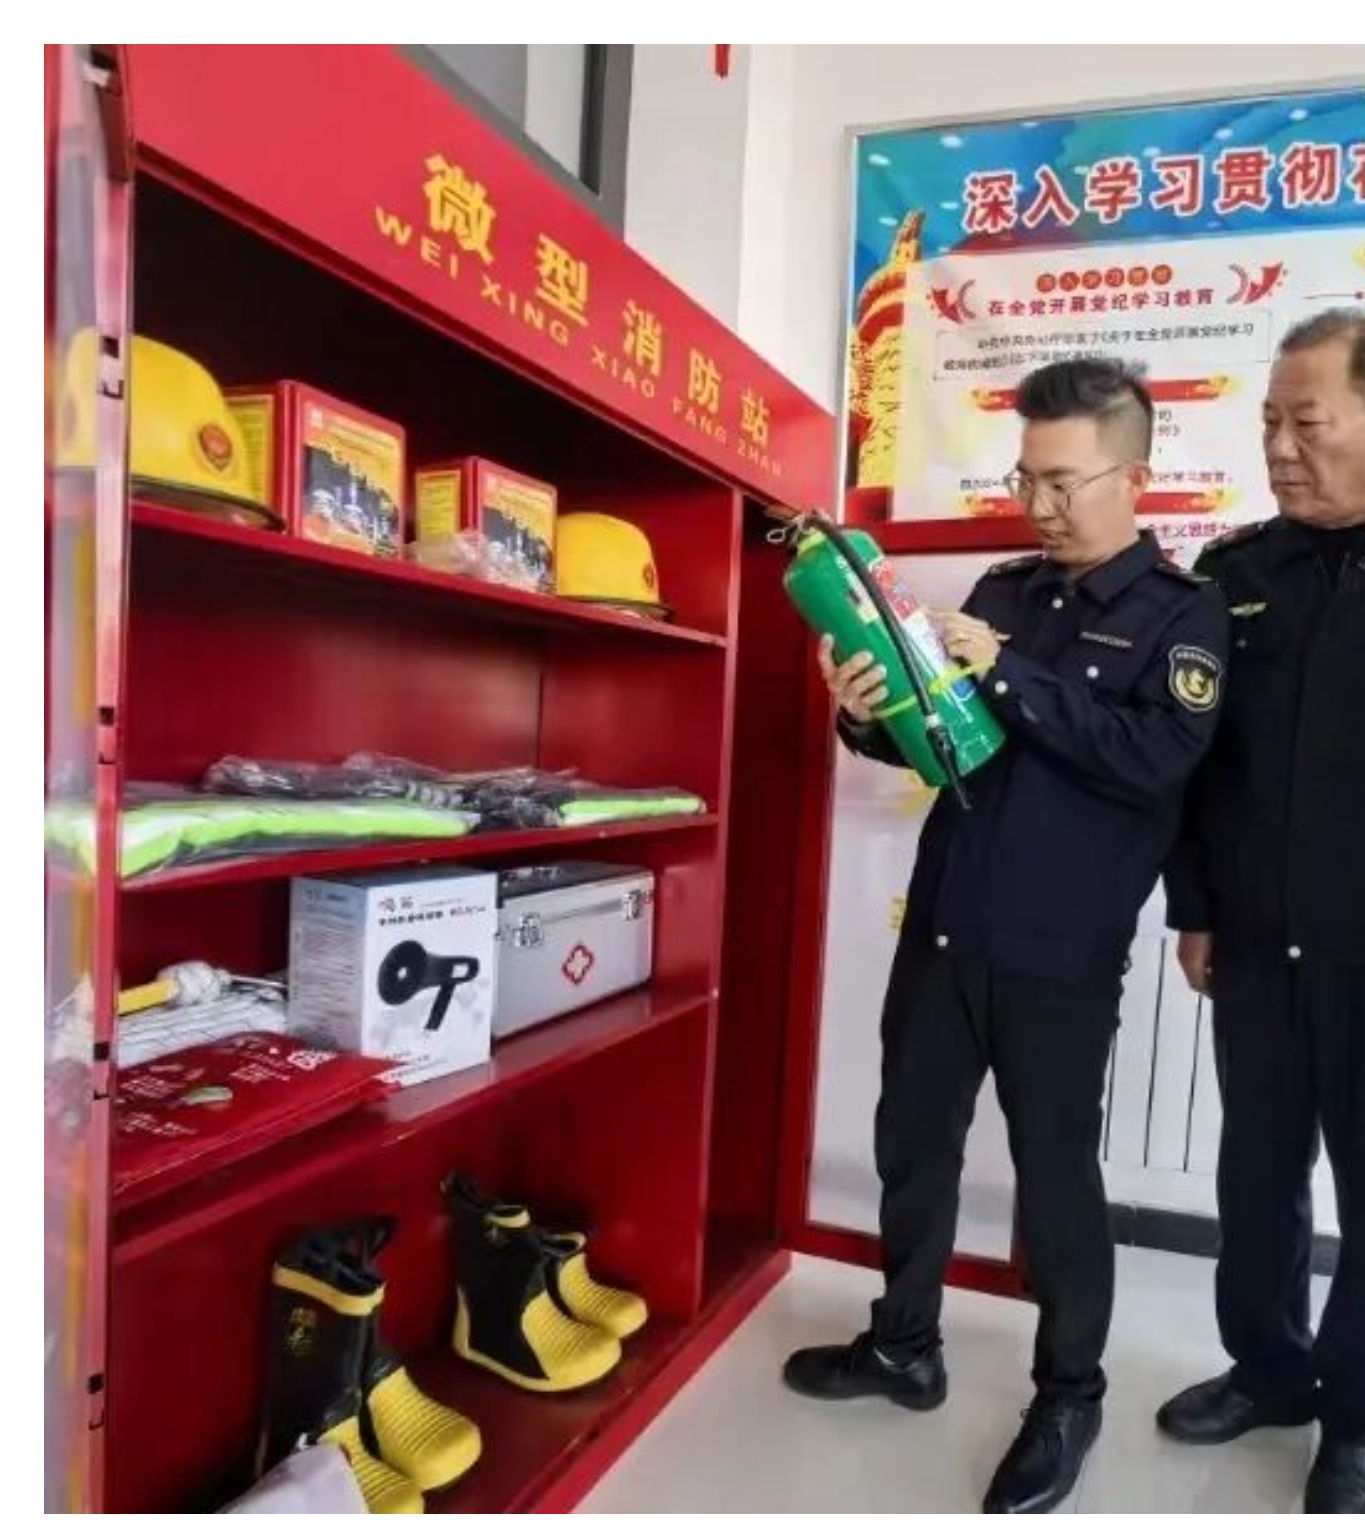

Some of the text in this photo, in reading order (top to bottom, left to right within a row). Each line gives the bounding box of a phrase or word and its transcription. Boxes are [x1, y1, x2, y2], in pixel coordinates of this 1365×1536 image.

[375, 207, 459, 279] WEI
[481, 274, 569, 346] XING
[591, 345, 656, 398] XIAO
[673, 397, 727, 444] FANG
[425, 153, 771, 447] 微型消防站
[987, 288, 1214, 317] 在全党开展党纪学习教育
